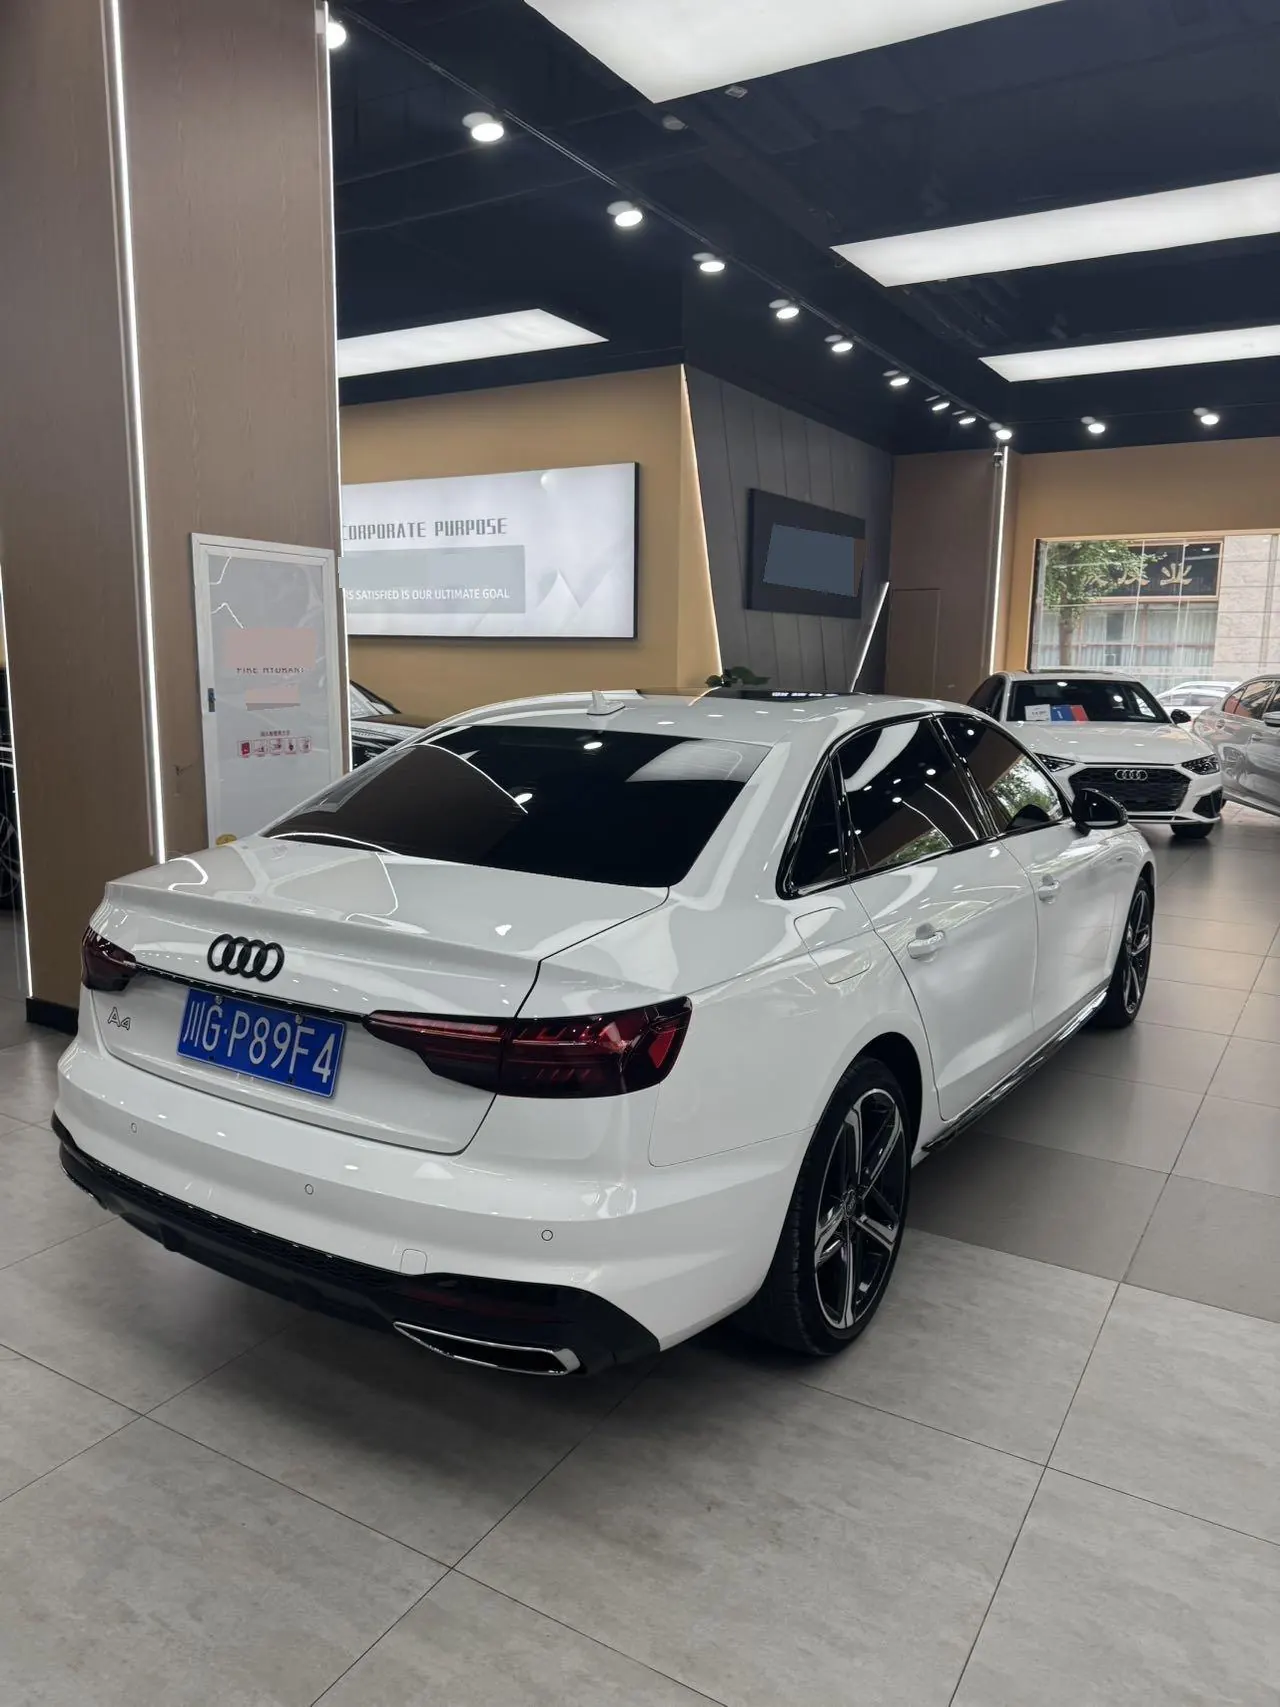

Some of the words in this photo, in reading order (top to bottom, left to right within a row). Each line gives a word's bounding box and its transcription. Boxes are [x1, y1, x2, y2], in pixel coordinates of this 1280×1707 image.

[434, 517, 508, 537] PURPOSE
[355, 589, 399, 600] SATISFIED
[401, 589, 410, 600] IS
[412, 589, 432, 600] OUR
[434, 588, 480, 600] ULTIMATE
[482, 587, 511, 600] GOAL
[107, 1006, 132, 1031] A4
